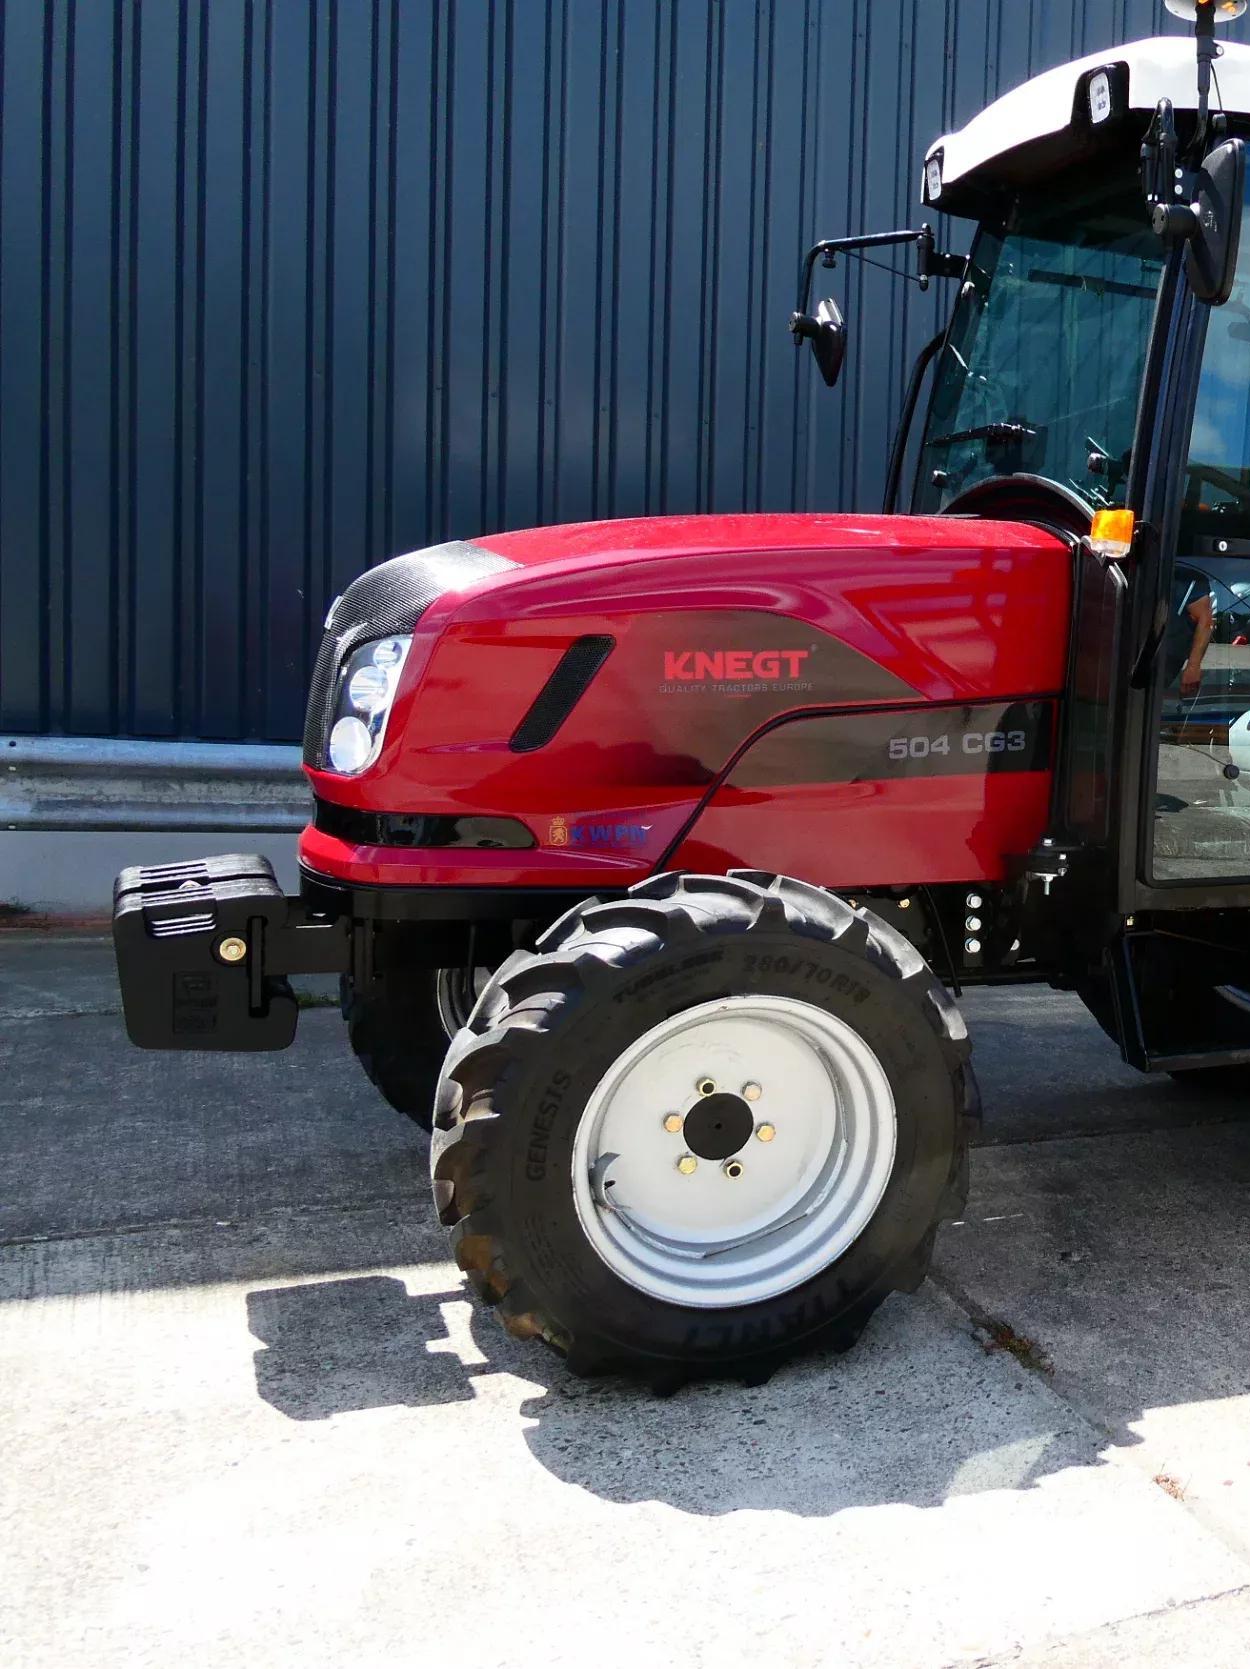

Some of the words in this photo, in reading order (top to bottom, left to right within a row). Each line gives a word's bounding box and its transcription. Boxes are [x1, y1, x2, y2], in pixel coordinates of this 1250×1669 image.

[664, 650, 808, 680] KNEGT
[658, 685, 707, 694] QUALITY
[711, 684, 768, 692] TRACTORS
[772, 681, 814, 691] EUROPE
[888, 735, 950, 760] 504
[962, 730, 1026, 754] CG3
[524, 1067, 573, 1182] GENESIS
